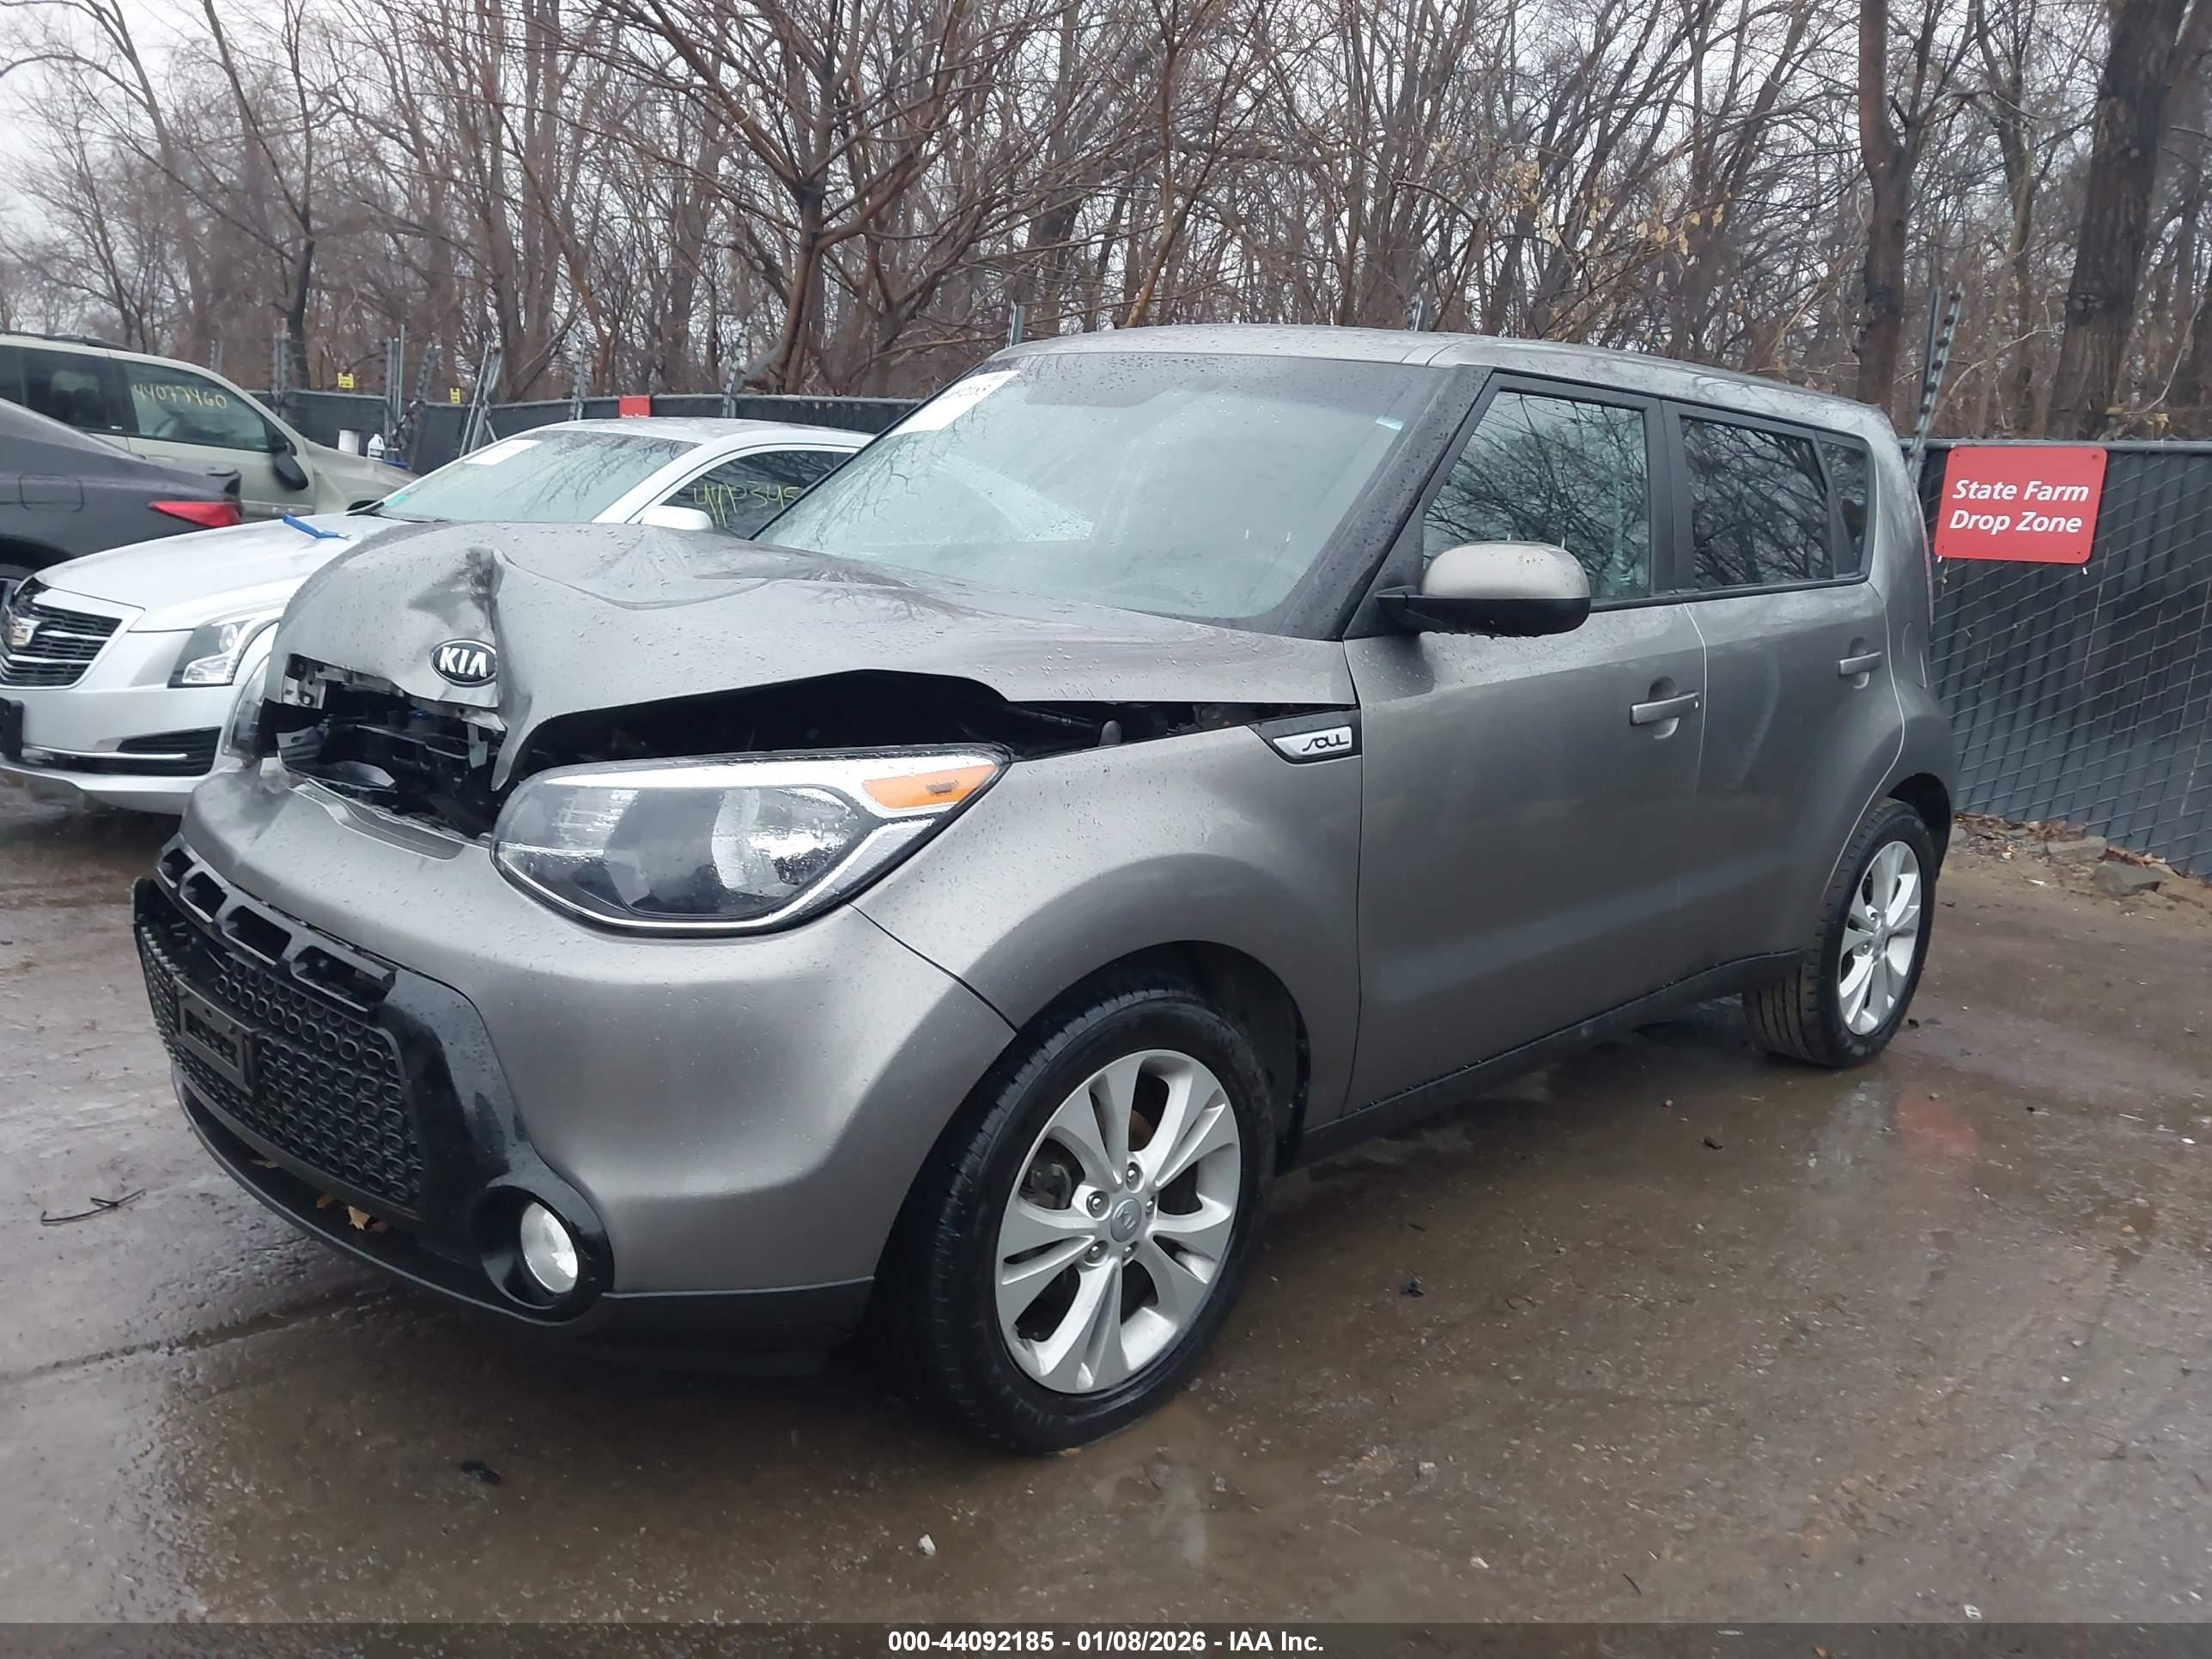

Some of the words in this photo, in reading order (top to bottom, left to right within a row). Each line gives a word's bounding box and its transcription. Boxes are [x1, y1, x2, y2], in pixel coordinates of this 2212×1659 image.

[1952, 479, 2018, 501] State
[2023, 480, 2089, 501] Farm
[1949, 509, 2011, 536] Drop
[2015, 511, 2082, 533] Zone
[439, 646, 488, 678] KIA
